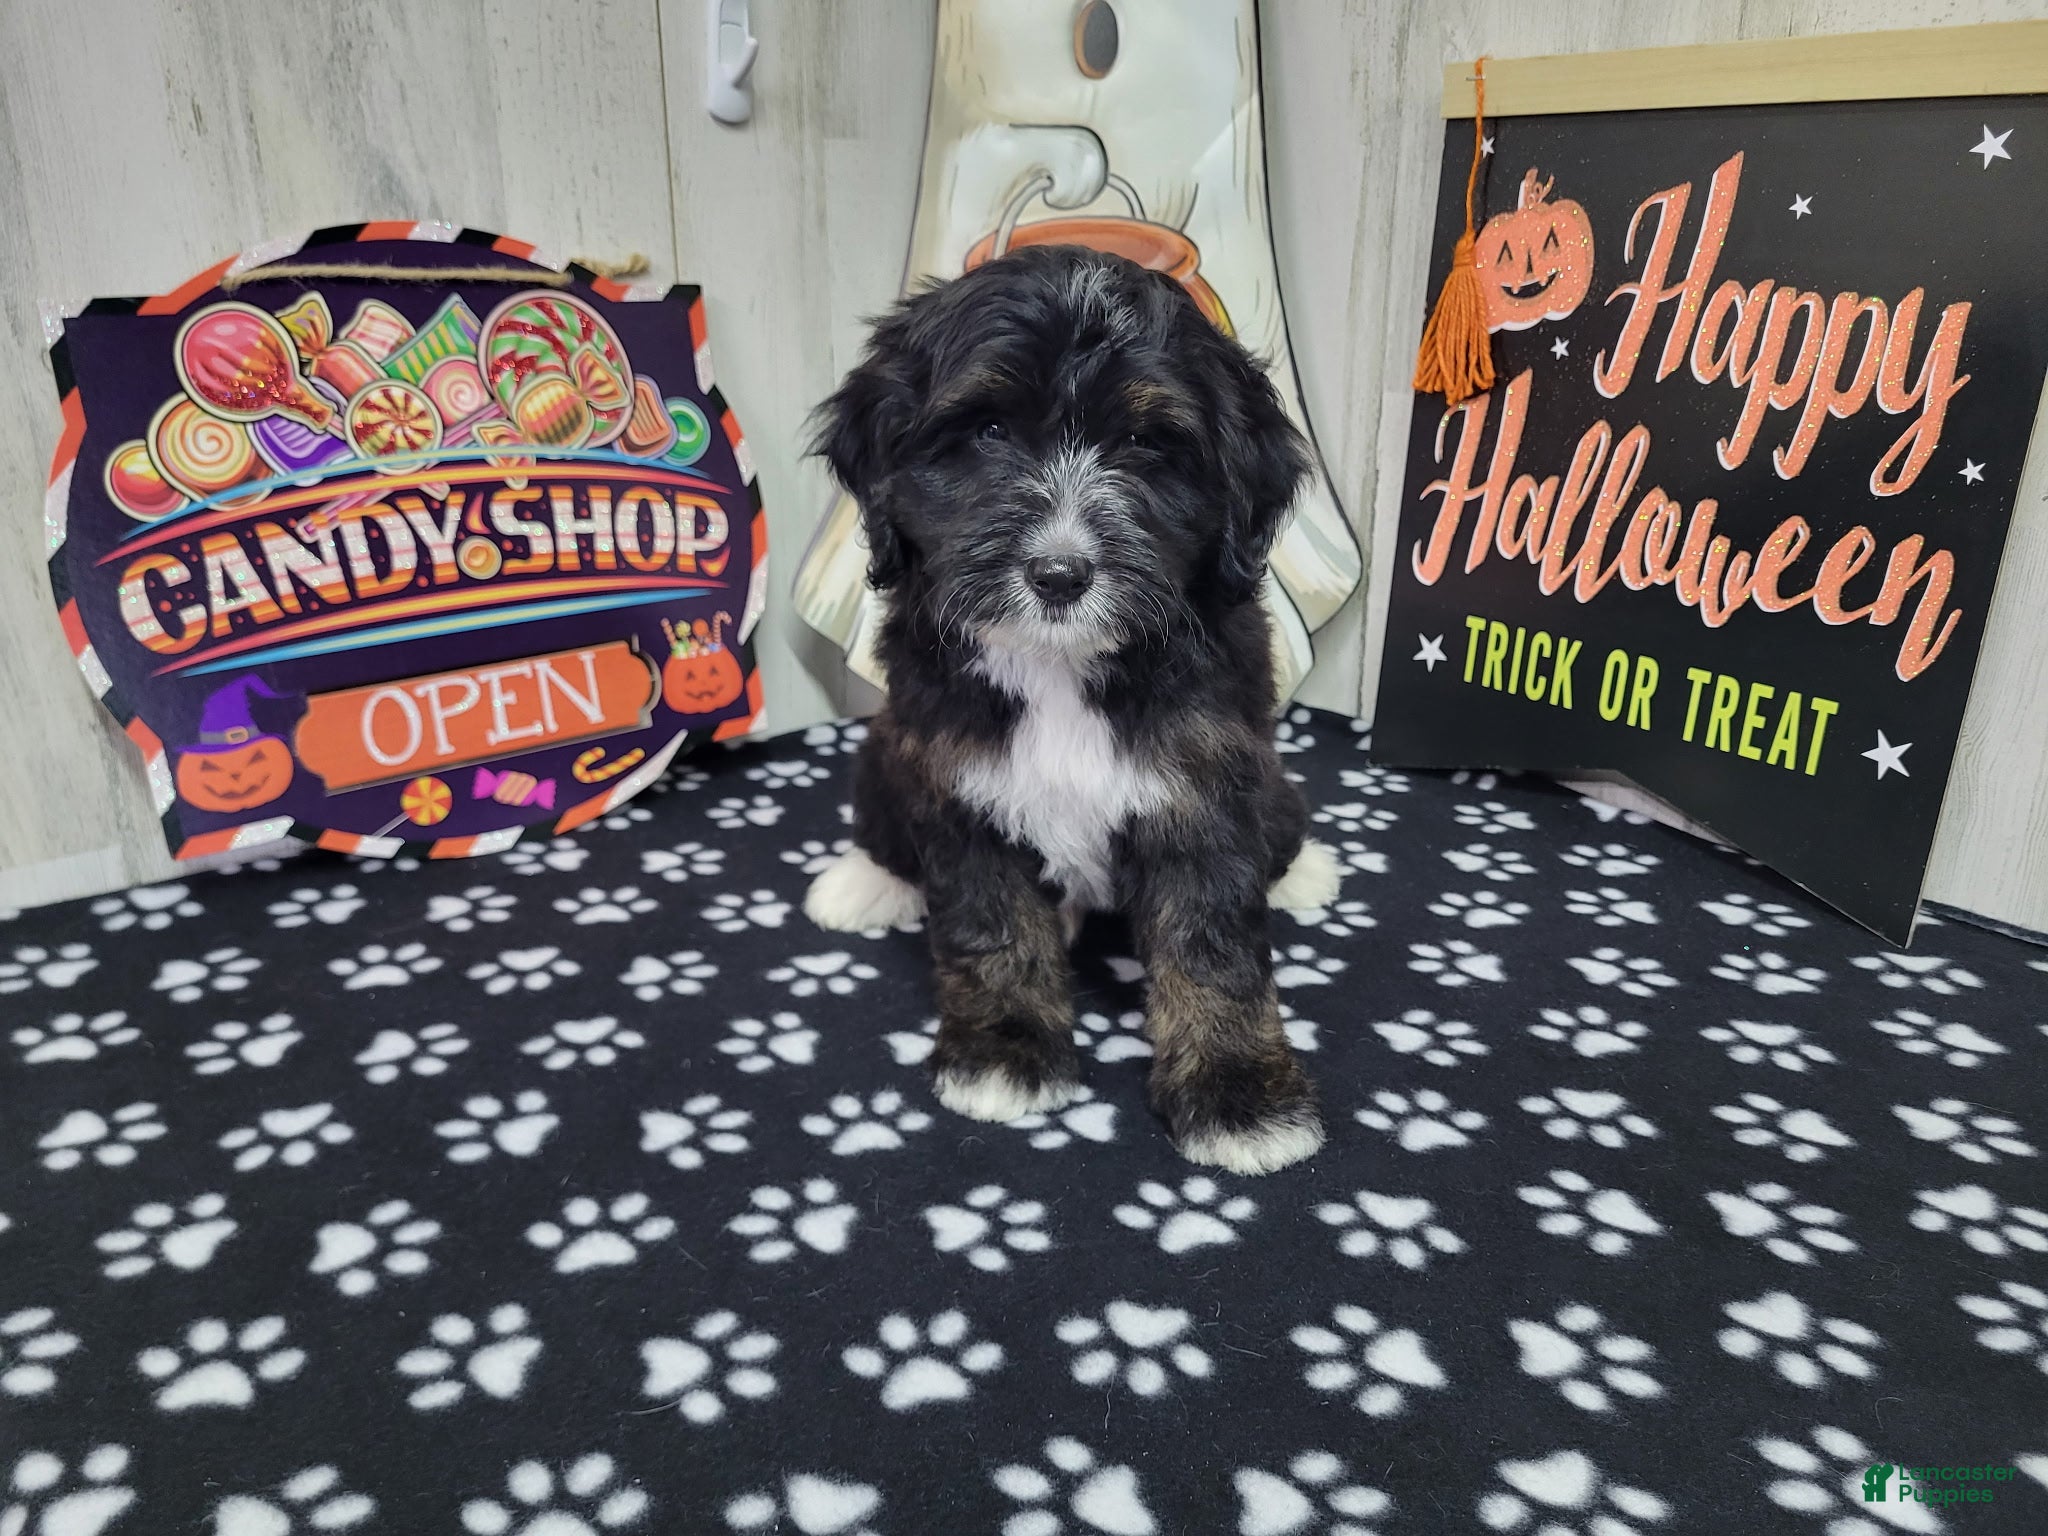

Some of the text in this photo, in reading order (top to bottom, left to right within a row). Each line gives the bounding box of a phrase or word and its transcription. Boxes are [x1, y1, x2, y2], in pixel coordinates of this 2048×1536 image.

[1594, 150, 1972, 497] Happy
[118, 486, 730, 655] CANDY SHOP
[1412, 368, 1962, 682] Halloween
[362, 651, 605, 766] OPEN
[1463, 615, 1839, 776] TRICK OR TREAT
